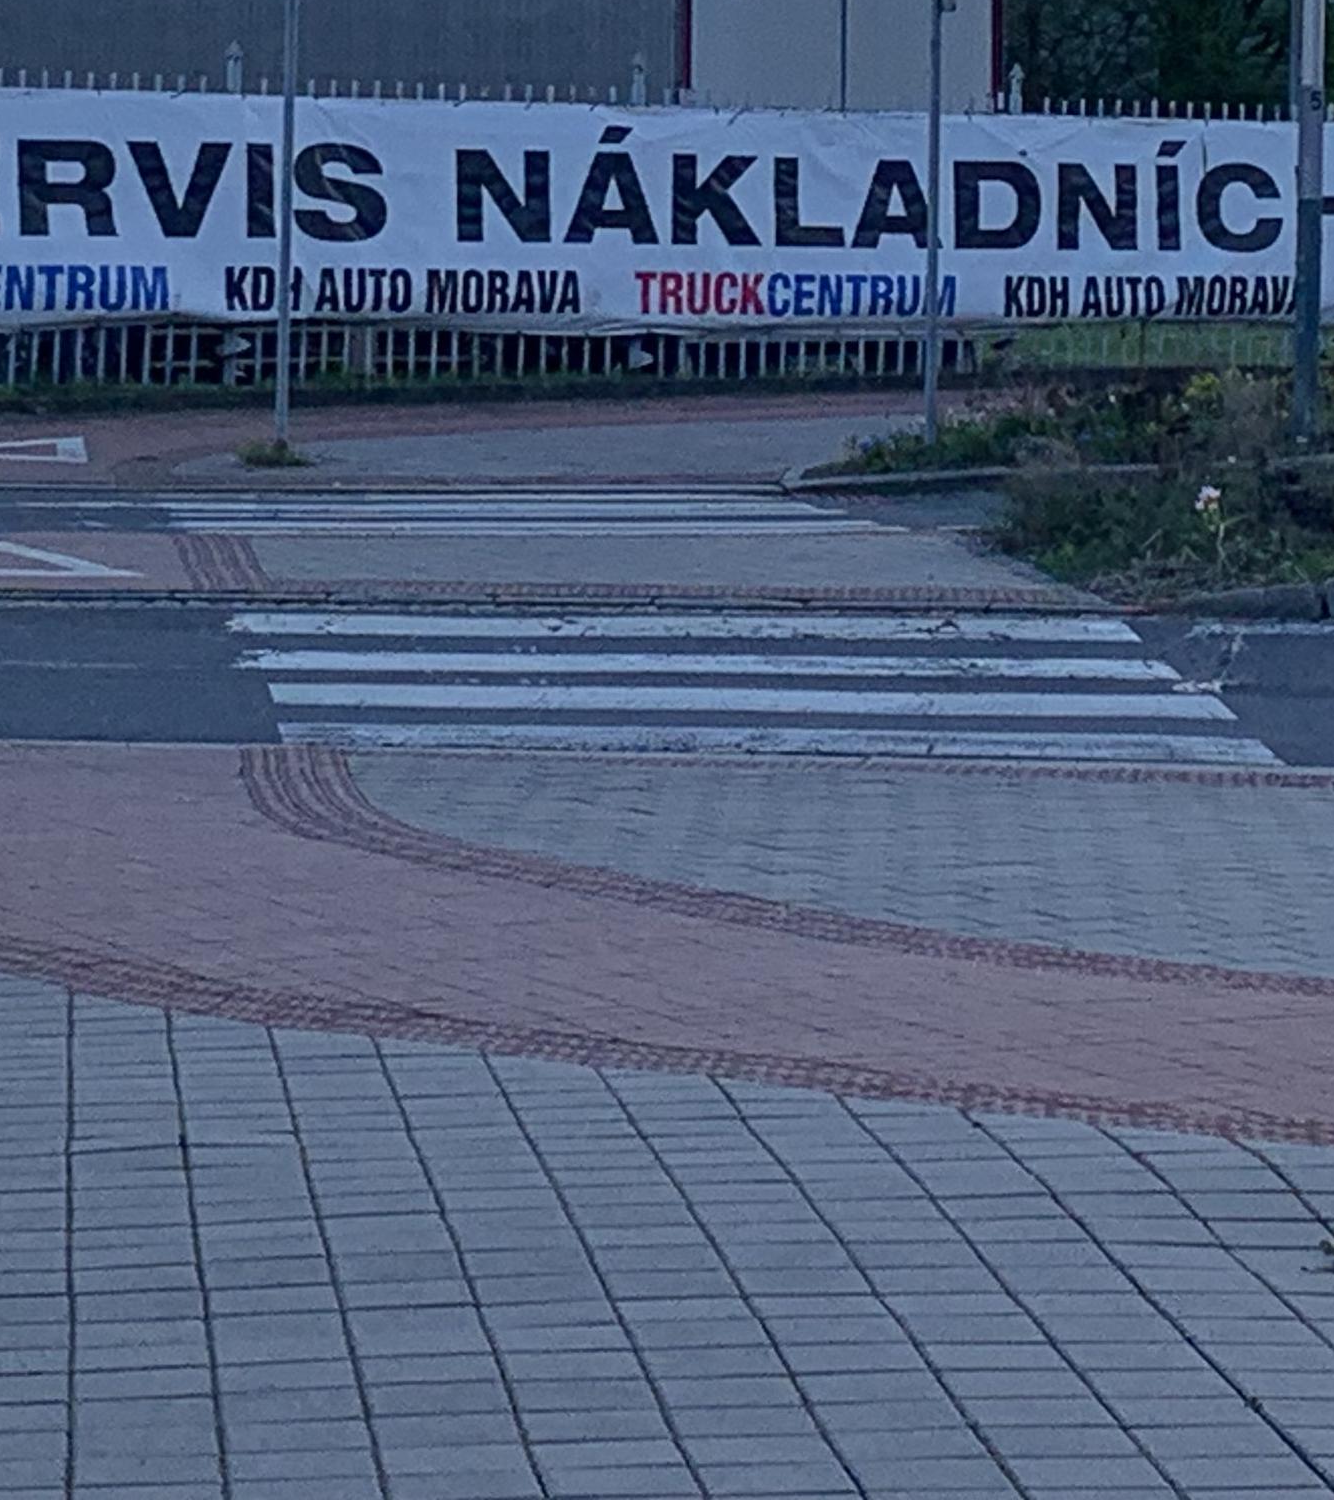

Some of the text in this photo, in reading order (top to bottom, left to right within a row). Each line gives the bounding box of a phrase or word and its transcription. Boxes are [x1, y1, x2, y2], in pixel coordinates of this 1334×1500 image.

[315, 267, 412, 313] AUTO
[426, 269, 581, 315] MORAVA
[1004, 275, 1069, 317] KDH
[1080, 275, 1166, 317] AUTO
[1174, 275, 1297, 316] MORAV
